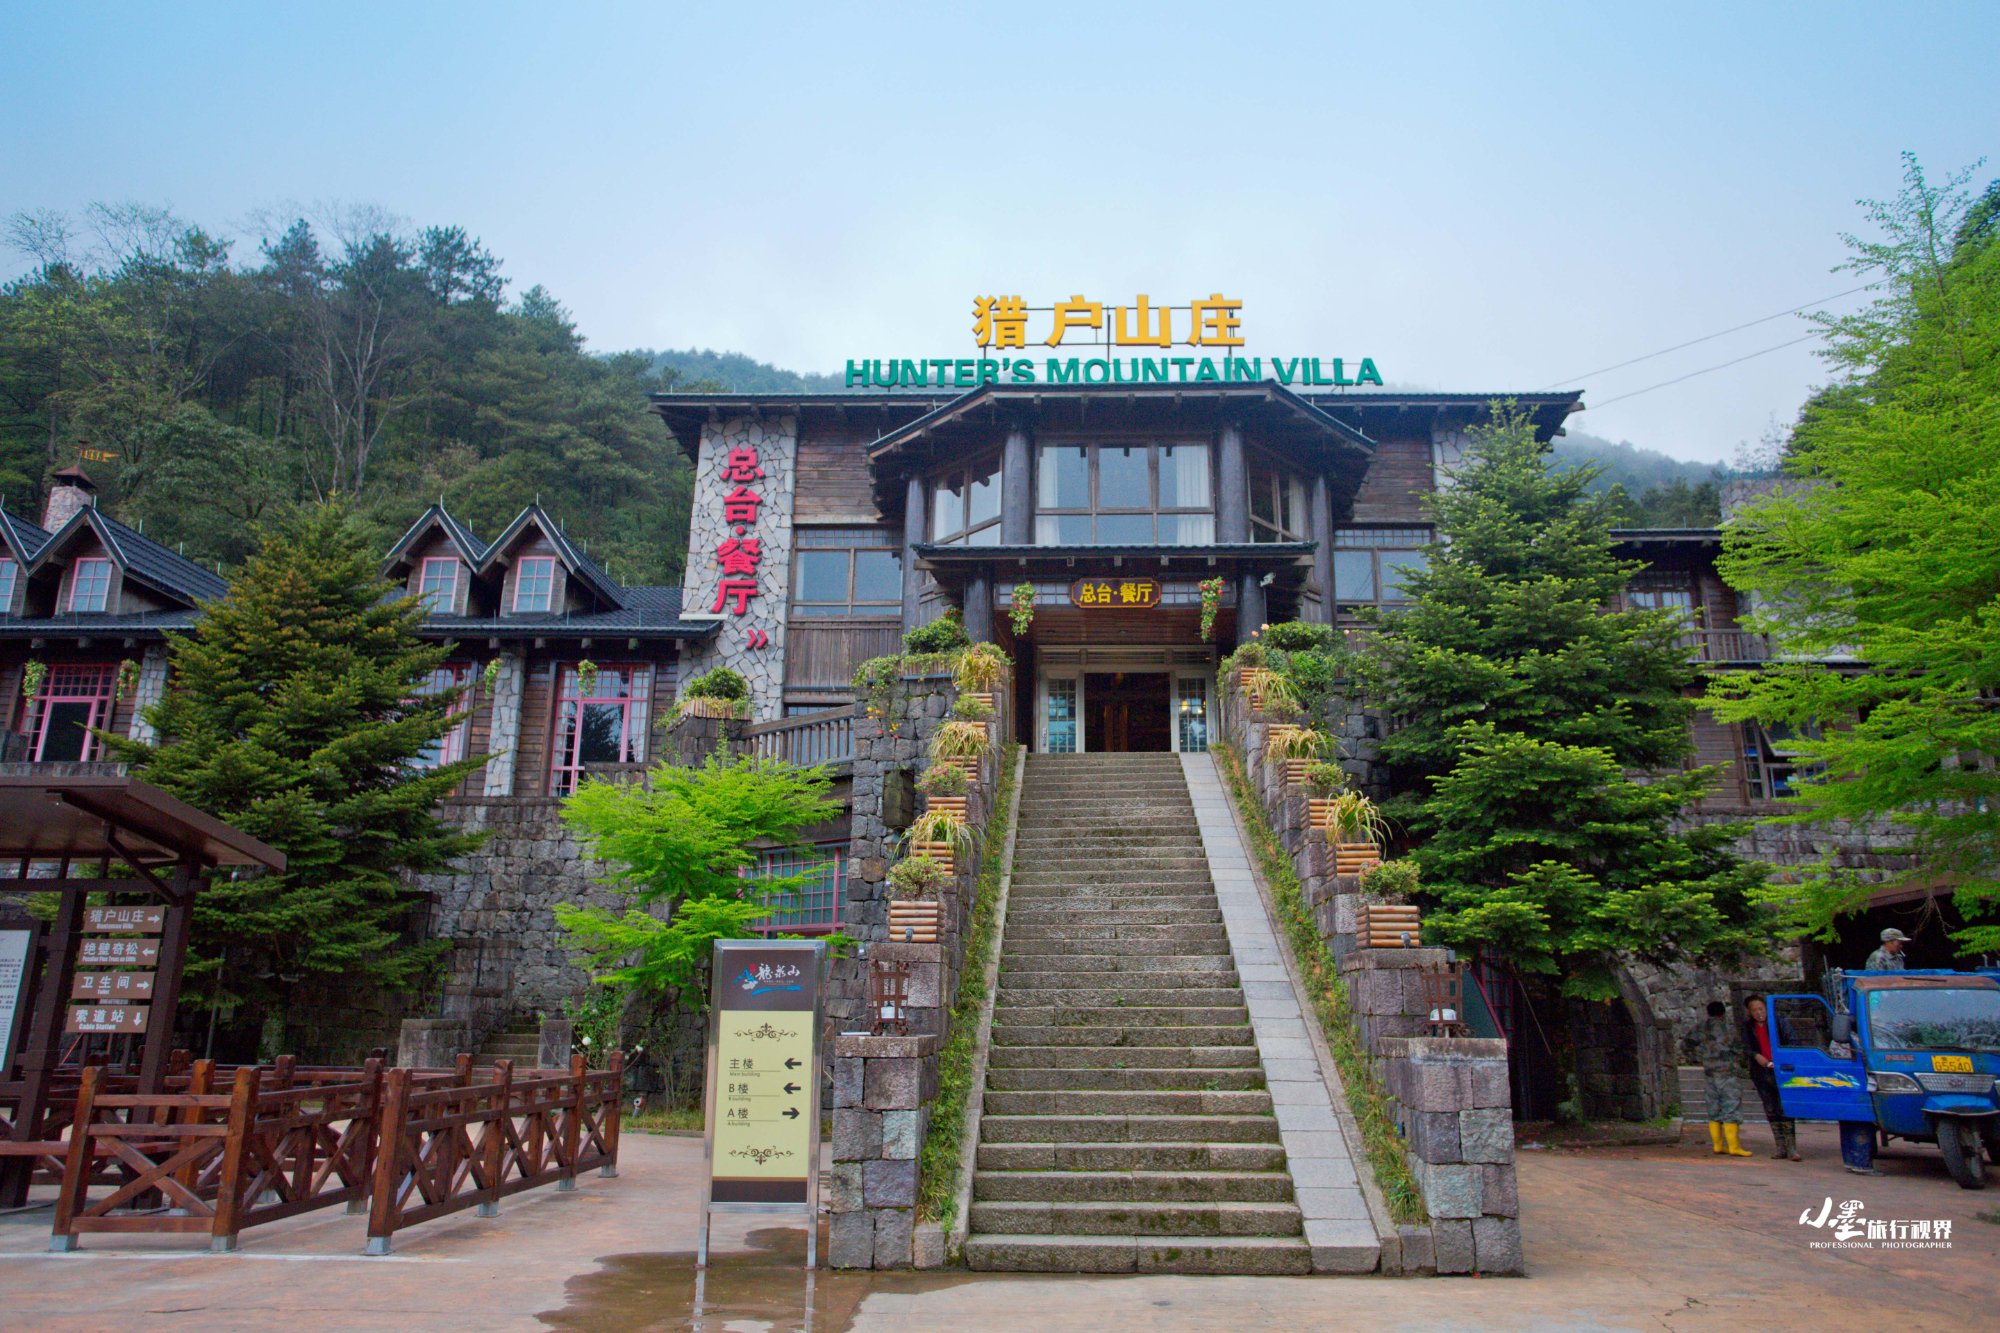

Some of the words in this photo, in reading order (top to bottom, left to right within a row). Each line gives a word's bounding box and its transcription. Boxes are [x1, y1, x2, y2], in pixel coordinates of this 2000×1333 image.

[972, 294, 1245, 349] 猎户山庄
[846, 357, 1036, 388] HUNTER'S
[1047, 357, 1263, 383] MOUNTAIN
[1271, 357, 1384, 386] VILLA
[90, 909, 144, 923] 猎户山庄
[83, 942, 138, 956] 绝壁奇松
[81, 976, 130, 989] 卫生间
[75, 1009, 124, 1023] 索道站
[729, 1058, 753, 1069] 主楼
